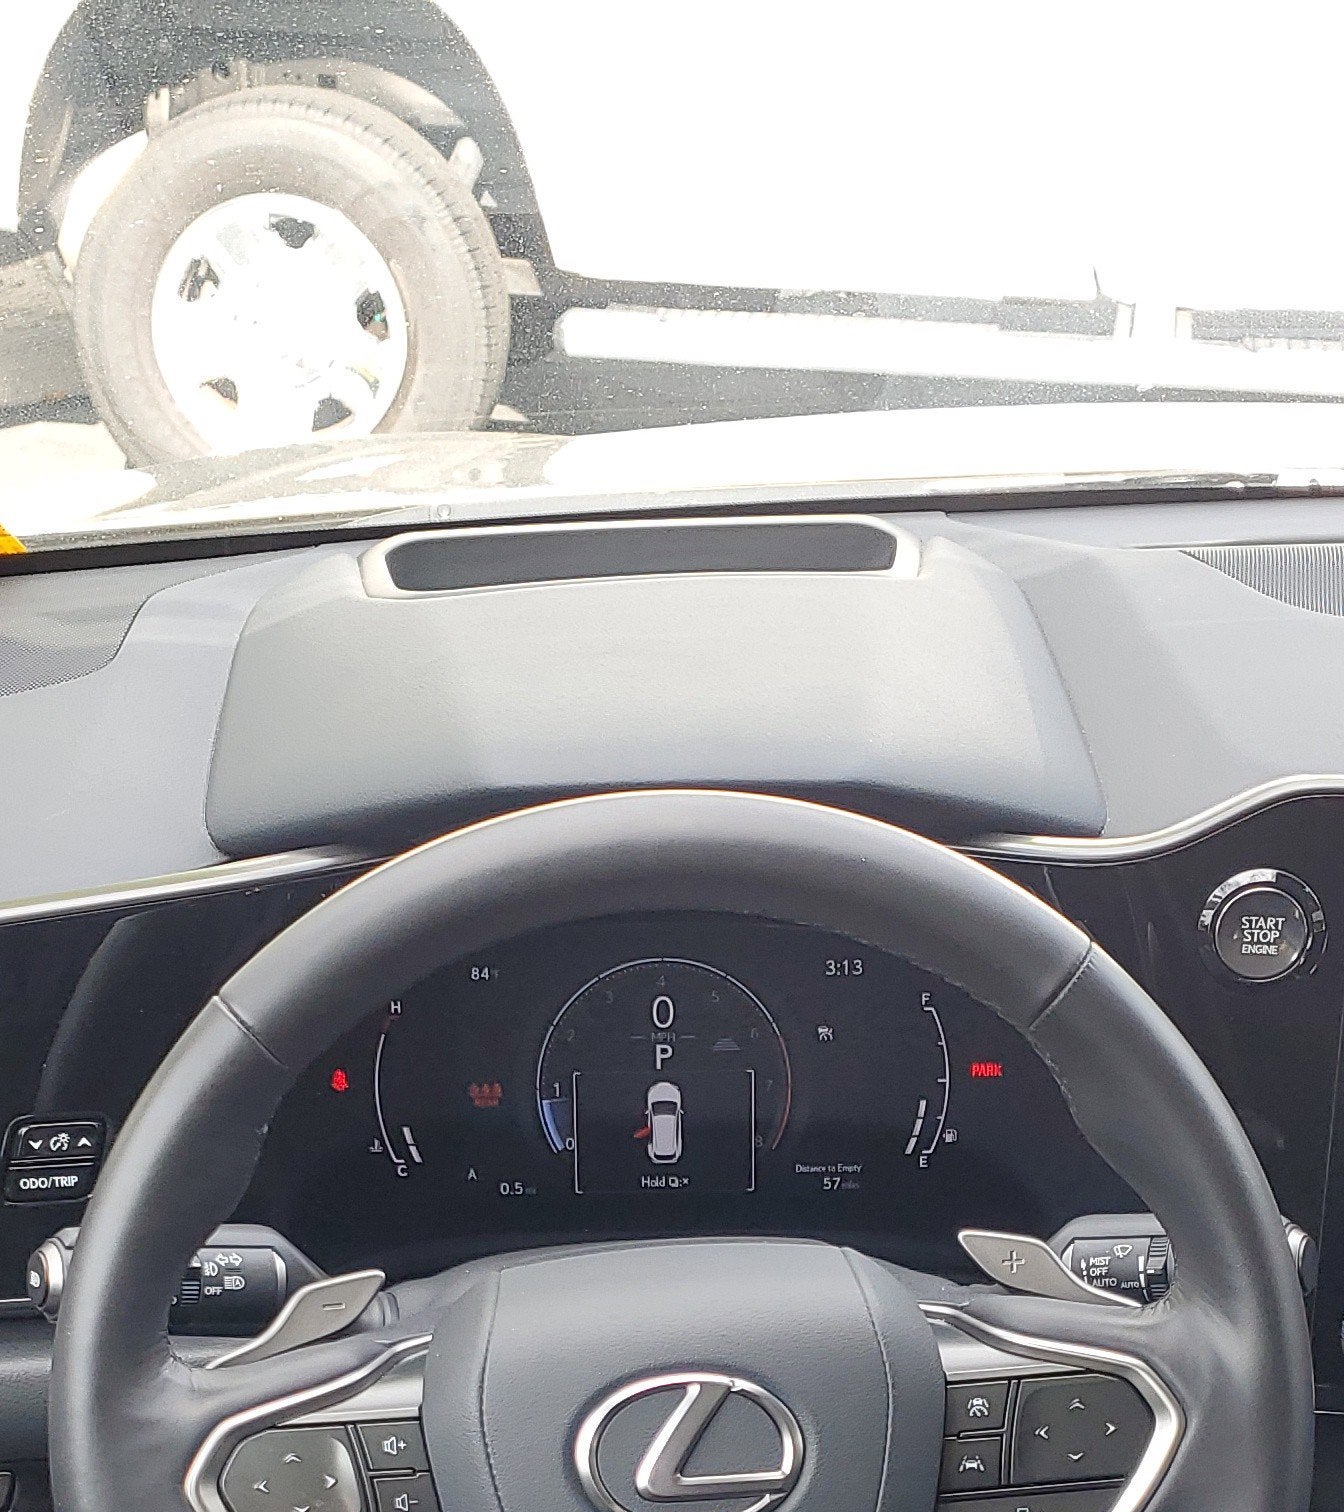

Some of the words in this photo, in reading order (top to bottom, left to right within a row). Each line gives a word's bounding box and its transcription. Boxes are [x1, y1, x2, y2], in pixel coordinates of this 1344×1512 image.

[1241, 917, 1286, 930] START
[1242, 930, 1280, 943] STOP
[1241, 944, 1278, 955] ENGINE
[470, 967, 490, 981] 84
[825, 959, 863, 976] 3:13
[921, 992, 931, 1005] F
[390, 1001, 402, 1014] H
[651, 995, 675, 1029] 0
[656, 1043, 674, 1070] P
[971, 1062, 1003, 1077] PARK
[552, 1082, 561, 1098] 1
[919, 1155, 929, 1168] E
[467, 1168, 478, 1180] A
[795, 1163, 826, 1173] Distance
[837, 1163, 862, 1174] Empty
[19, 1174, 79, 1191] ODO/TRIP
[641, 1175, 666, 1188] Hold
[823, 1177, 842, 1191] 57
[500, 1182, 524, 1196] 0.5
[1089, 1256, 1112, 1267] MIST
[1089, 1267, 1110, 1277] OFF
[1092, 1277, 1118, 1287] AUTO
[1120, 1281, 1140, 1289] AUTO
[204, 1286, 224, 1296] OFF
